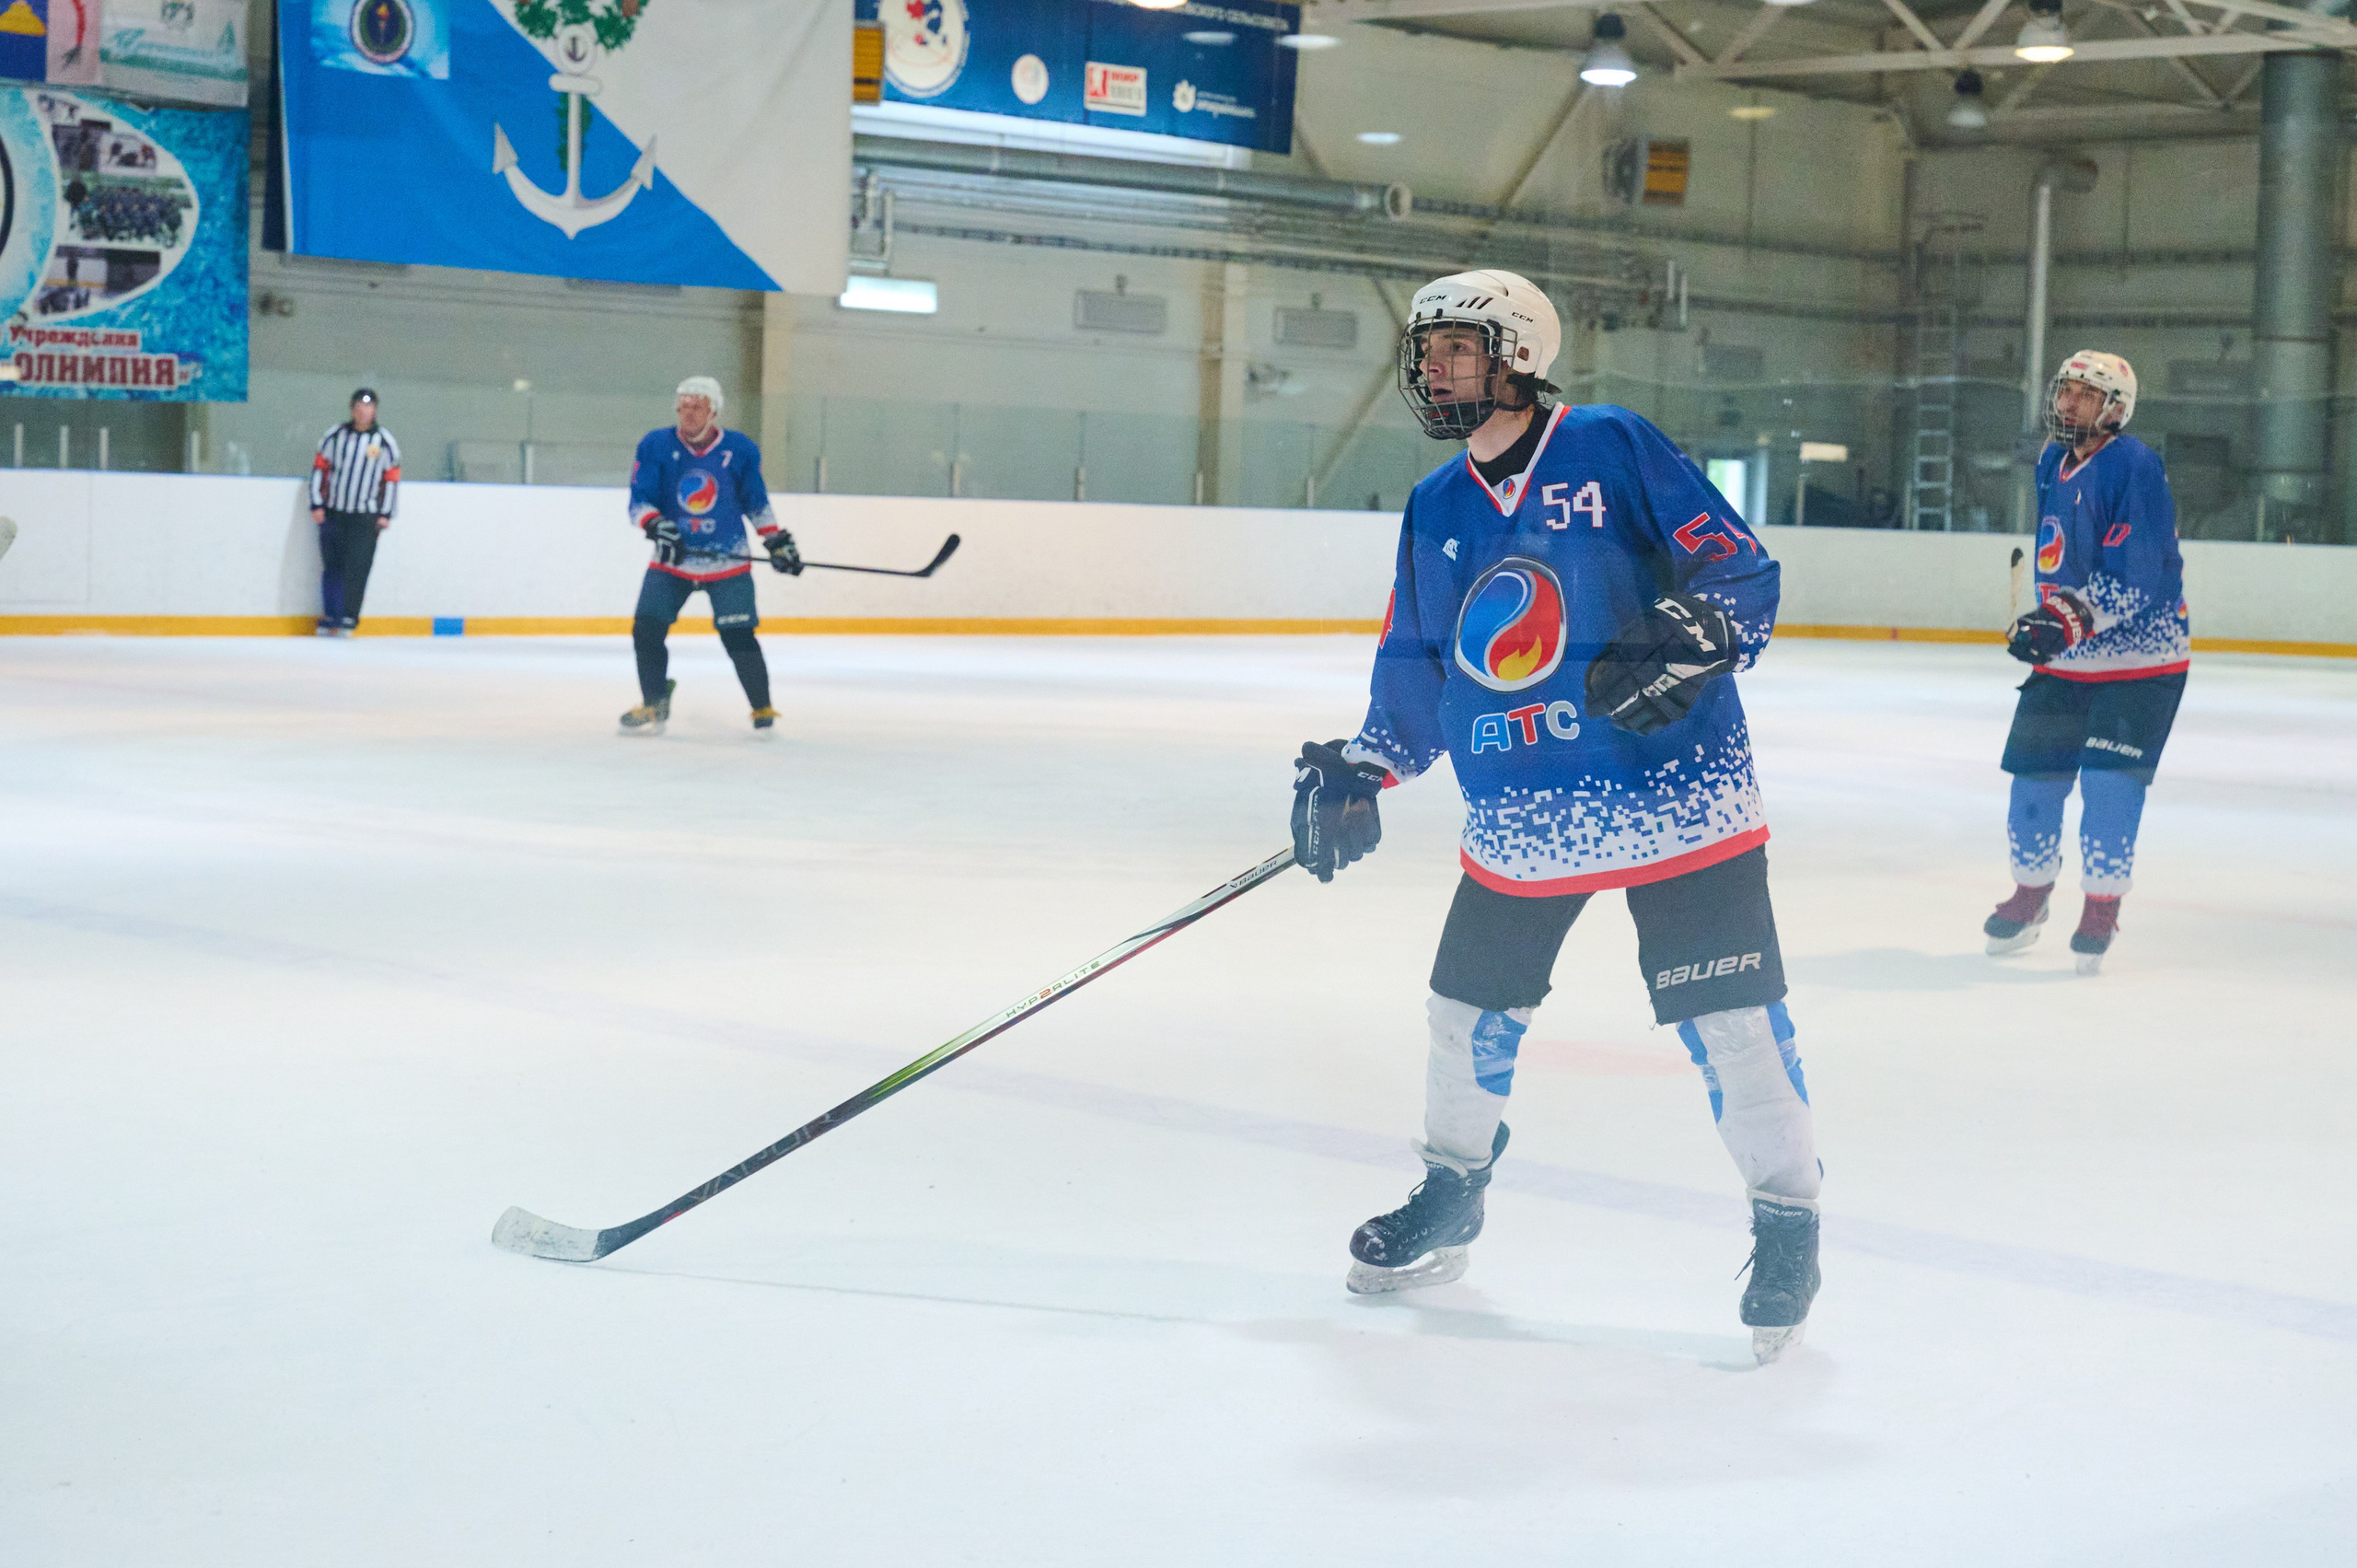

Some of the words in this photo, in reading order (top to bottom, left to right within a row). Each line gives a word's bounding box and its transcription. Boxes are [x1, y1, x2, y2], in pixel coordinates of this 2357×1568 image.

[1420, 295, 1447, 305] CCM
[1511, 311, 1534, 323] CCM
[721, 450, 733, 469] 7
[1541, 481, 1607, 530] 54
[1655, 598, 1717, 653] CM
